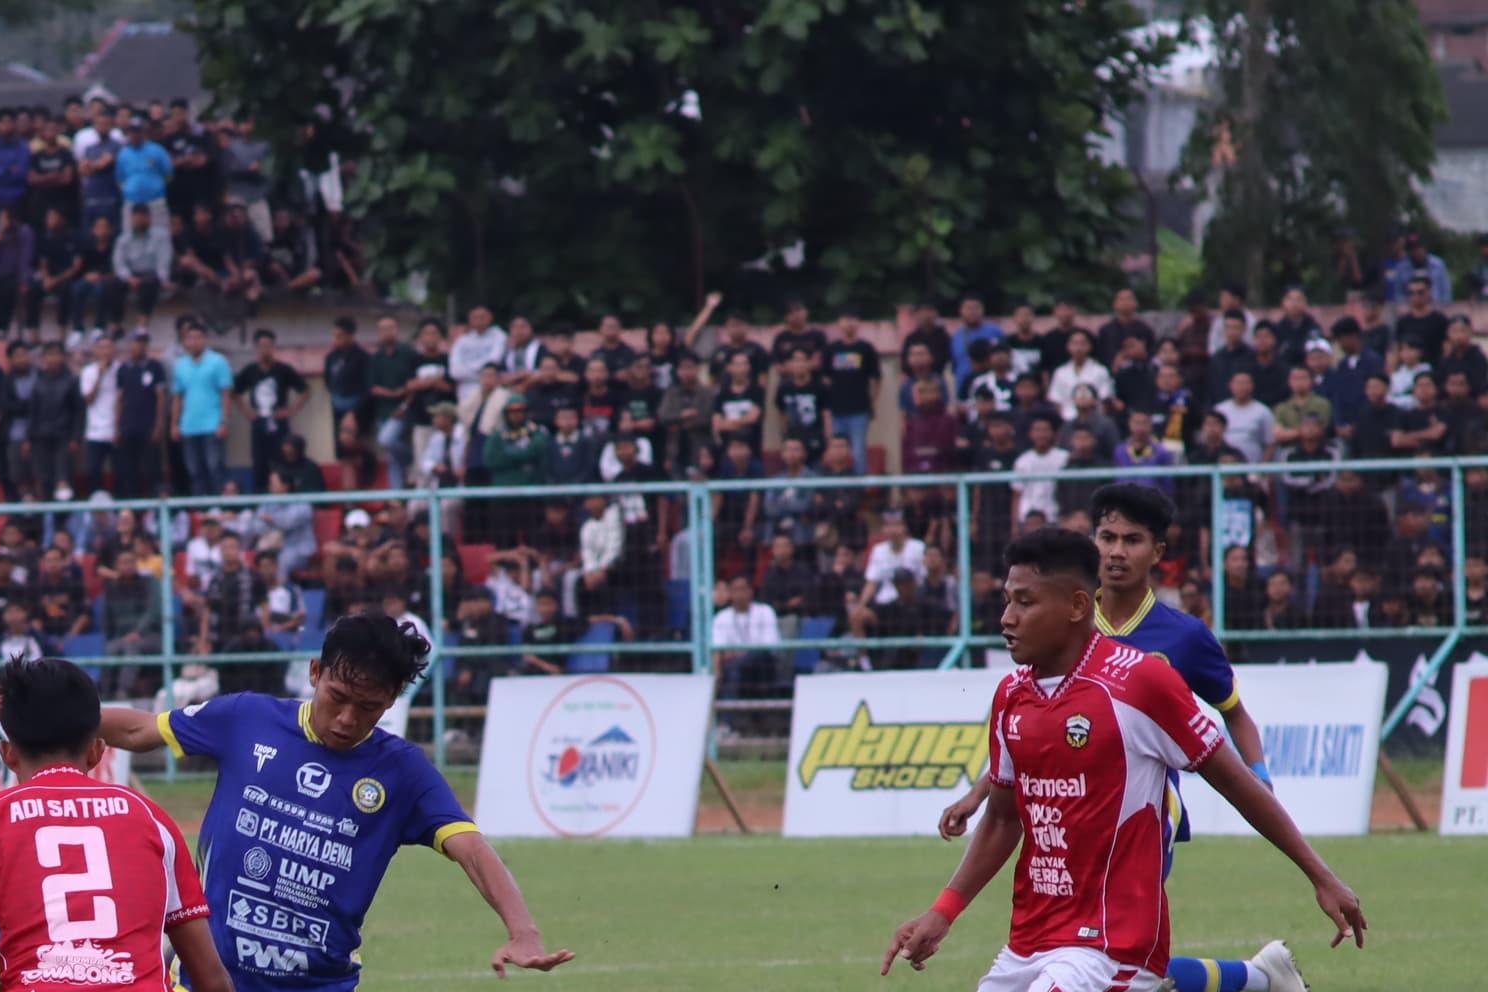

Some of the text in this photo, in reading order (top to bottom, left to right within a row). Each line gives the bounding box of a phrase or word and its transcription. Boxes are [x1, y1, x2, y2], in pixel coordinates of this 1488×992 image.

[851, 765, 964, 791] SHOES
[10, 797, 129, 823] ADI SATRIO
[278, 825, 321, 860] HARYA
[320, 839, 353, 868] DEWA
[35, 825, 119, 942] 2
[279, 858, 336, 890] UMP
[252, 905, 323, 942] SBPS
